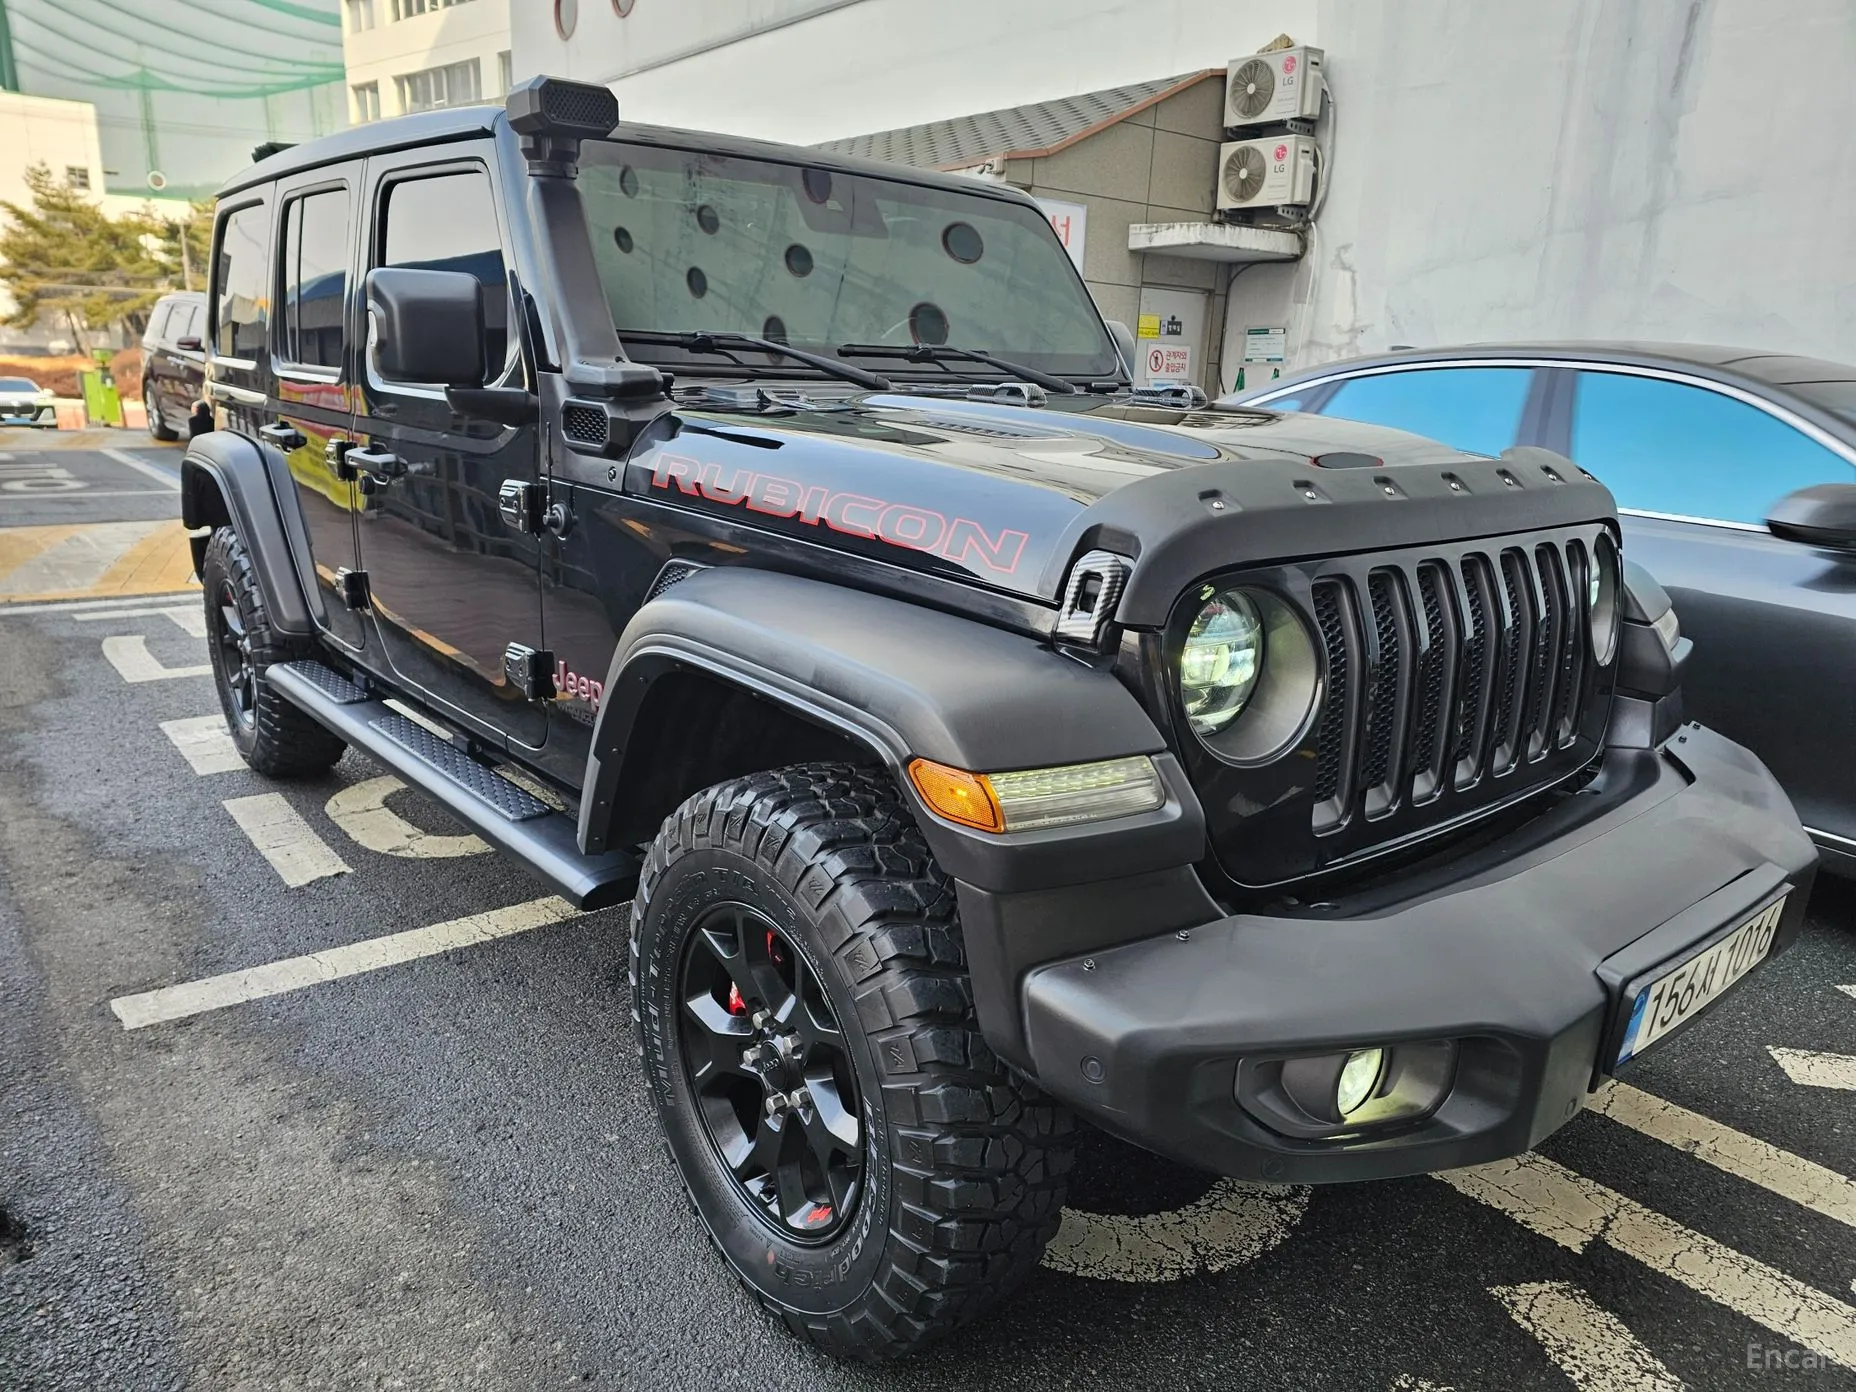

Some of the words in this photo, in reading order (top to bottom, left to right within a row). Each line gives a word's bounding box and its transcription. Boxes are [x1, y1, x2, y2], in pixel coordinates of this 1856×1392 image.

[1282, 76, 1294, 86] LG
[1273, 163, 1285, 174] LG
[1165, 350, 1188, 361] 관계자외
[1164, 363, 1187, 373] 출입금지
[651, 452, 1030, 574] RUBICON
[551, 660, 604, 714] Jeep
[1646, 949, 1722, 1039] 156서
[1722, 905, 1778, 986] 1016
